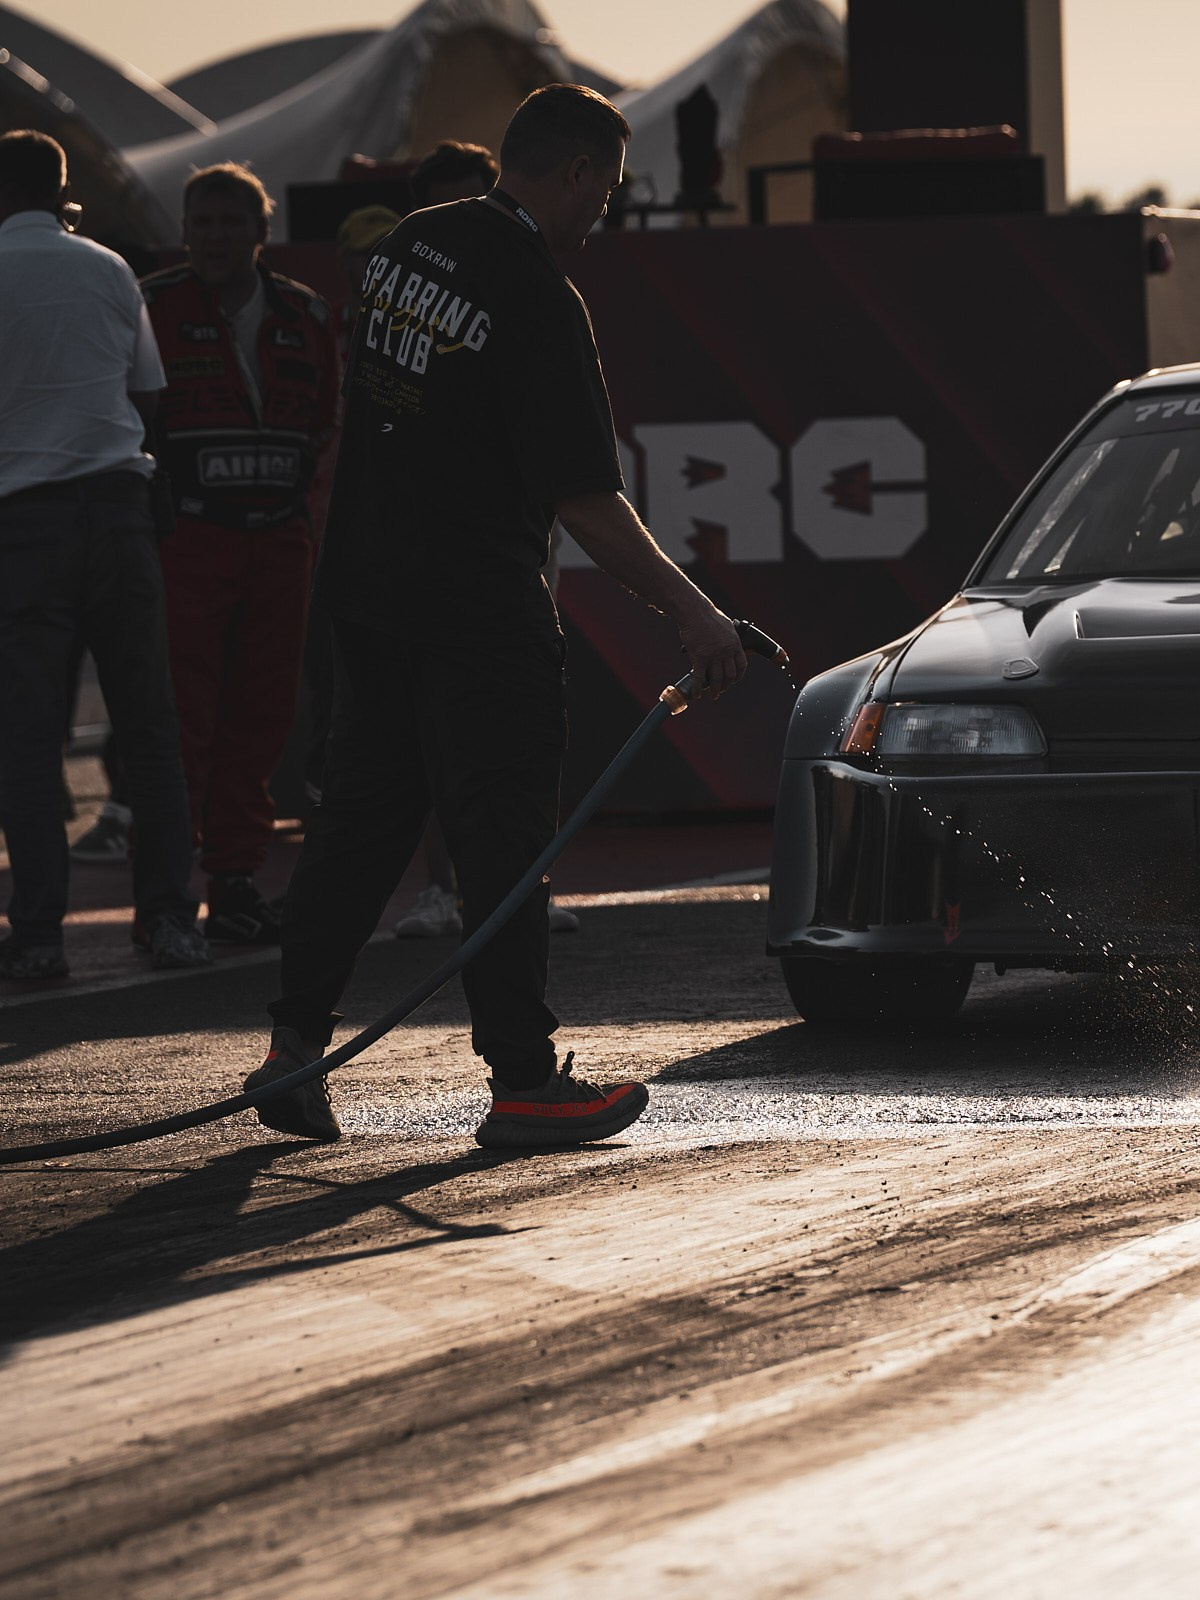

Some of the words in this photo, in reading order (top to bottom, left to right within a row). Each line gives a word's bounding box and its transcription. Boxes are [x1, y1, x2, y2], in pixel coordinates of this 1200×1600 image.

[412, 241, 457, 273] BOXRAW
[362, 255, 492, 352] SPARRING
[366, 308, 432, 375] CLUB
[556, 415, 929, 568] RC
